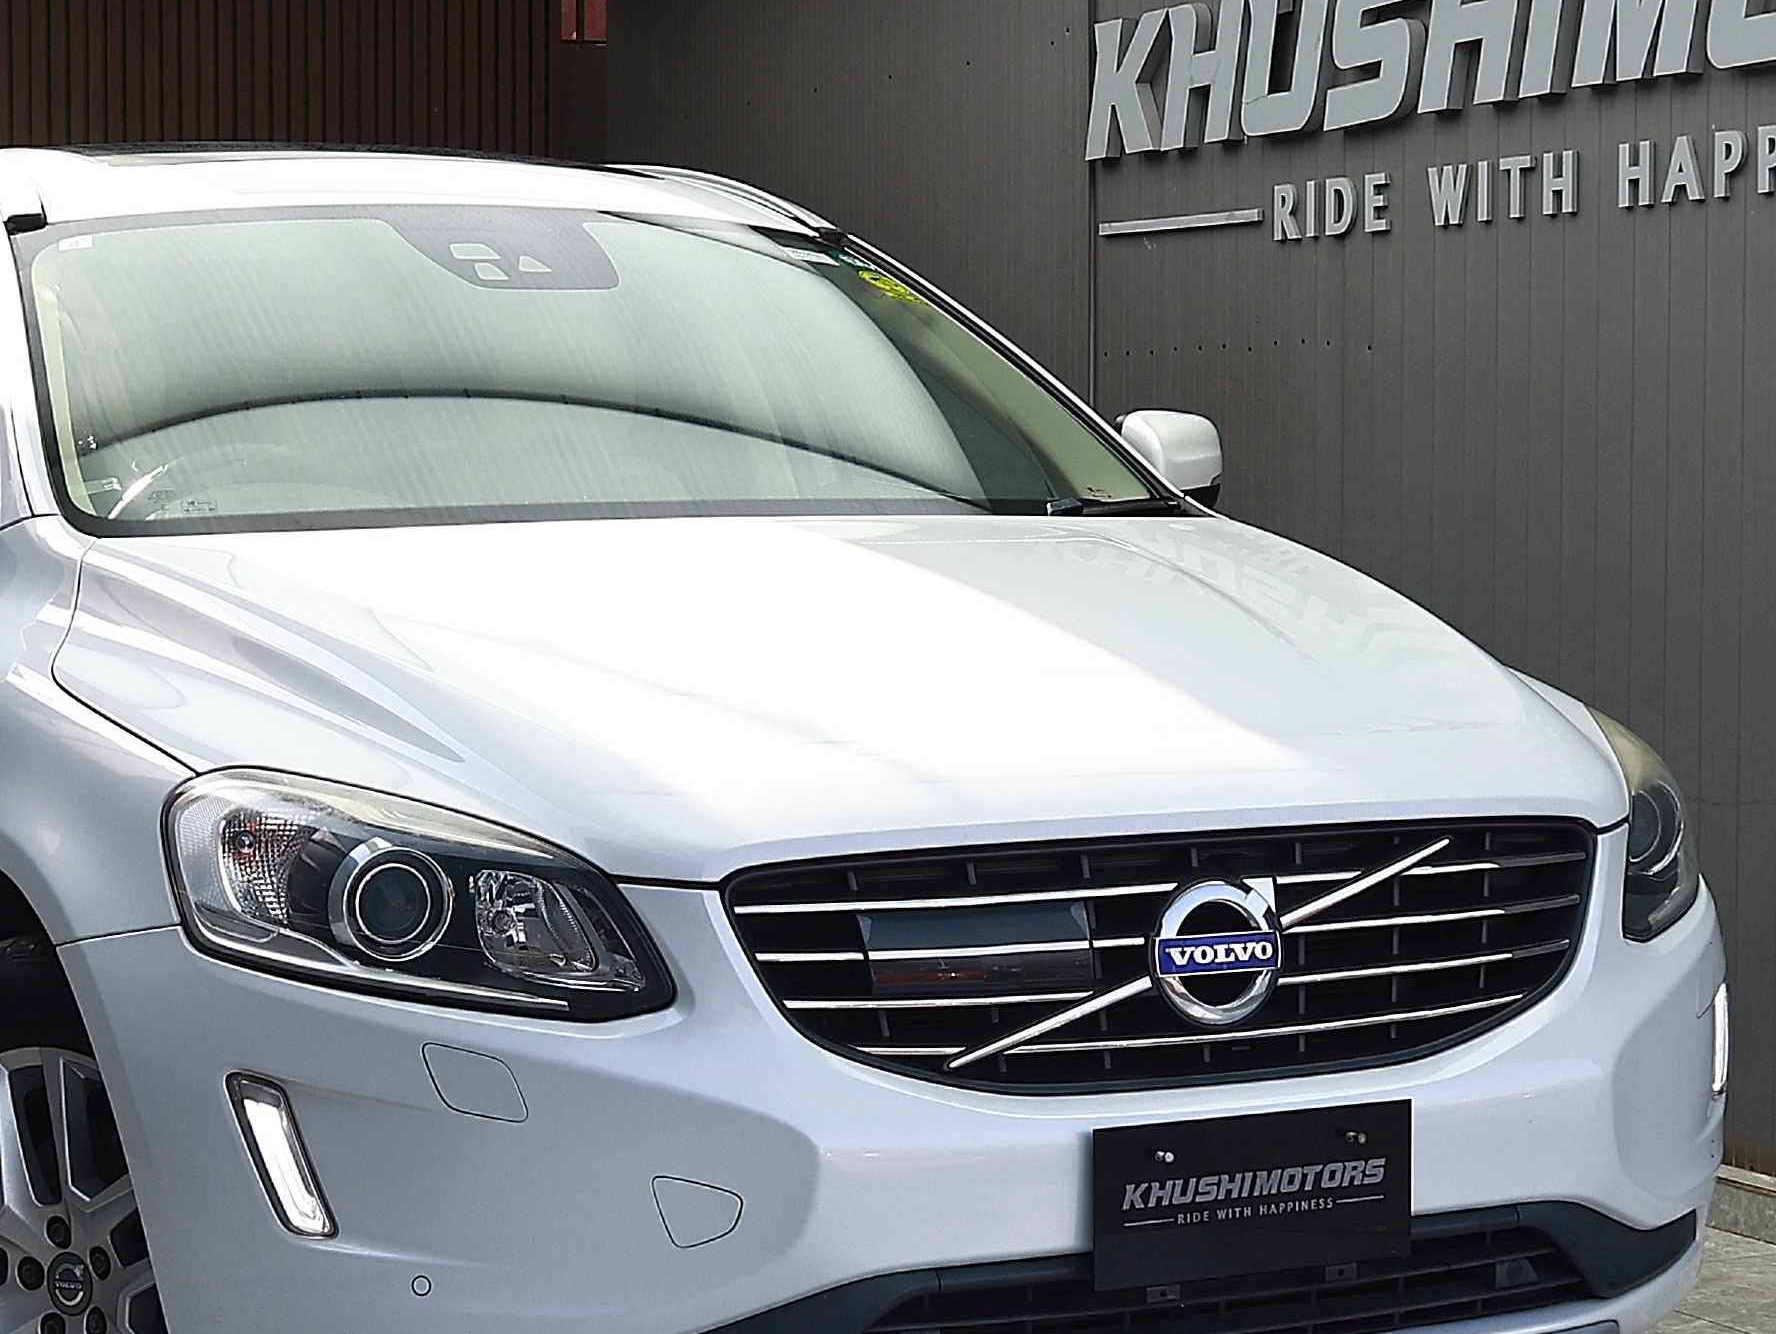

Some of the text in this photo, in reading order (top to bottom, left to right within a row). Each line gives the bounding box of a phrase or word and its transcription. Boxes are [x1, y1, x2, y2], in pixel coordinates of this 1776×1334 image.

[1273, 172, 1392, 242] RIDE
[1427, 149, 1578, 227] WITH
[1165, 941, 1273, 966] VOLVO
[1122, 1157, 1387, 1211] KHUSHIMOTORS
[1177, 1197, 1334, 1225] RIDE WITH HAPPINESS
